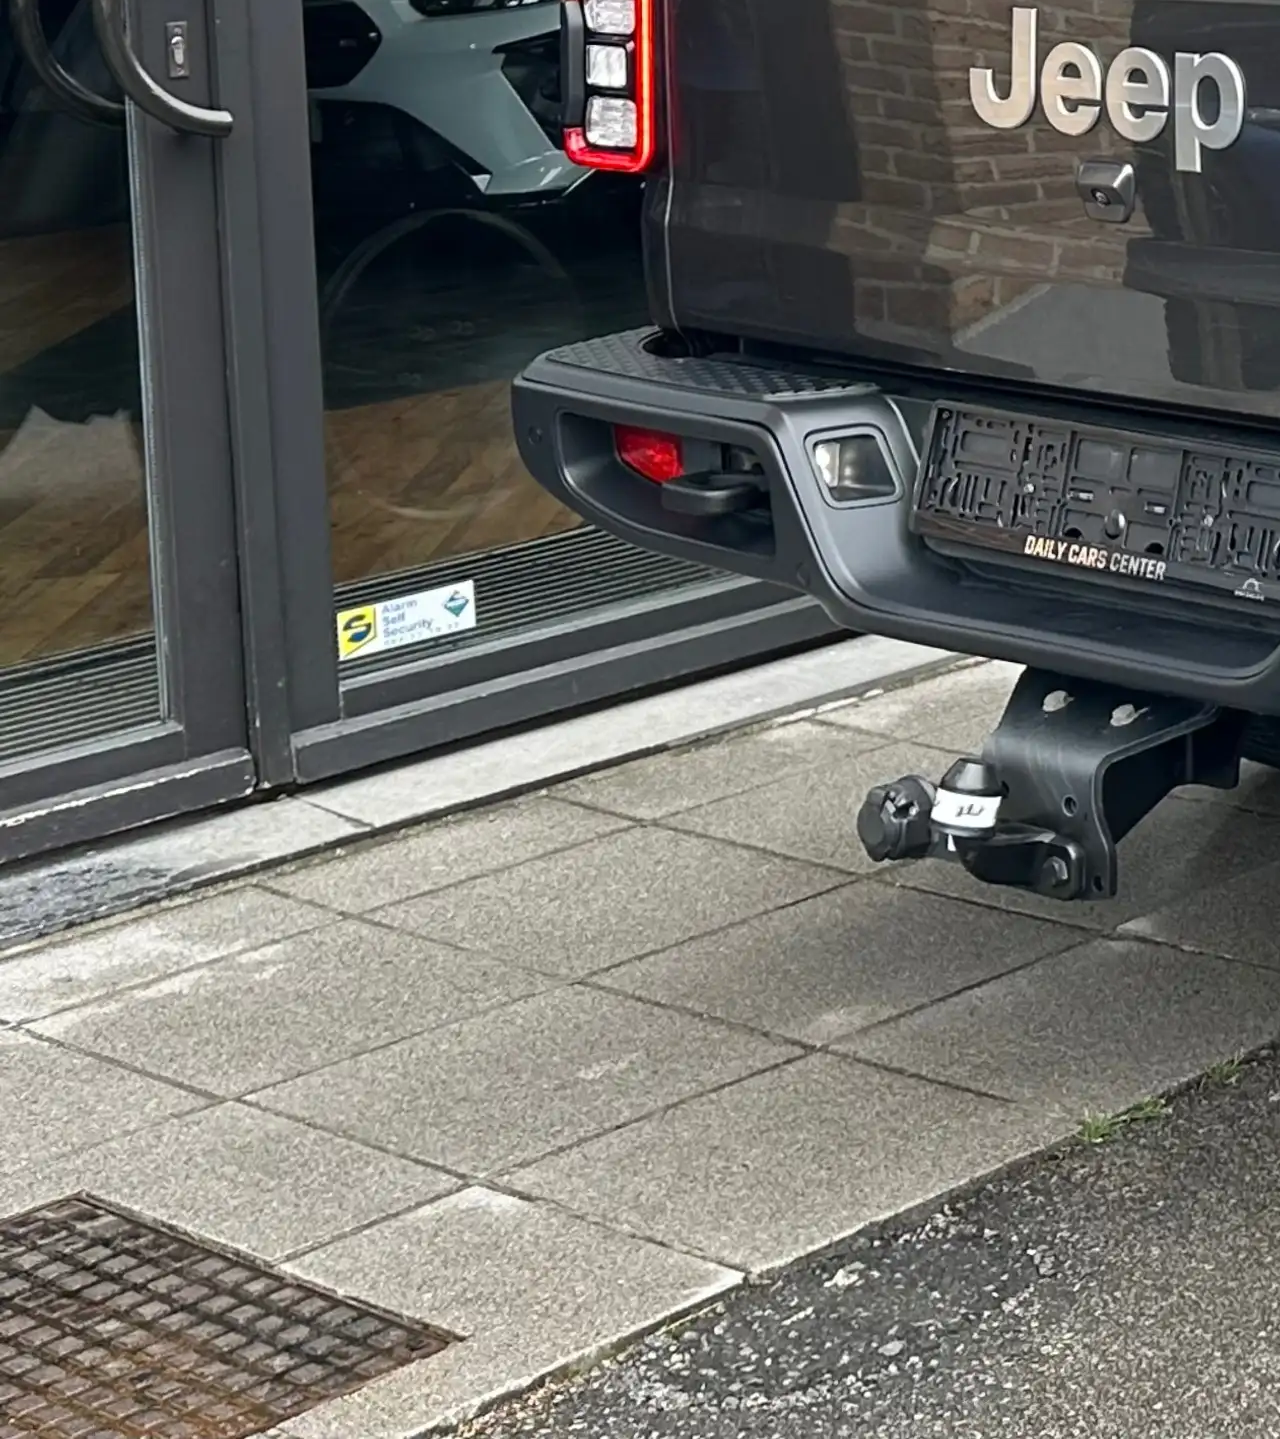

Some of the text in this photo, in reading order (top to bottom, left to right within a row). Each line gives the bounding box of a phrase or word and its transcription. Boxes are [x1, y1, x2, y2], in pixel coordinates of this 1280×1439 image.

[969, 6, 1245, 173] Jeep
[1024, 535, 1167, 580] DAILY CARS CENTER
